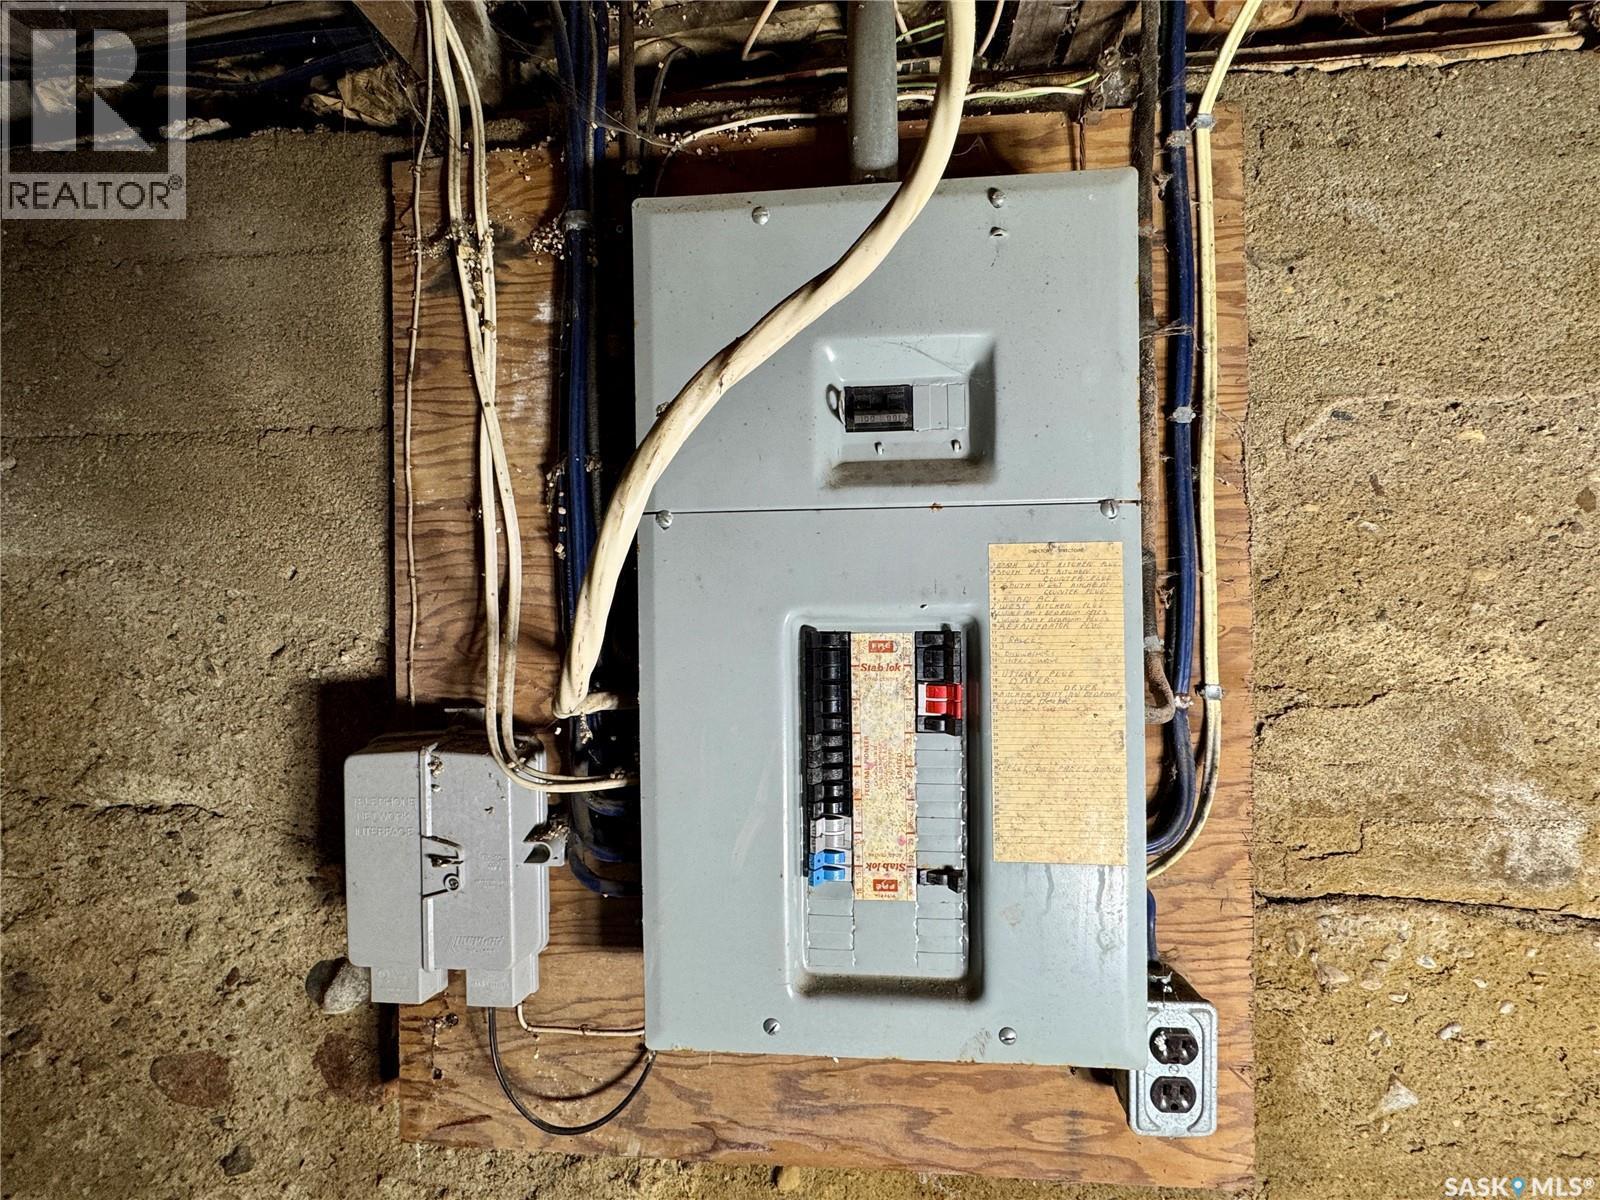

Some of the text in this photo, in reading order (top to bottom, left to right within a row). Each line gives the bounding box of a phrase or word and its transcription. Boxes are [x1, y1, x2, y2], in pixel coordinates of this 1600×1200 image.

[860, 662, 902, 672] Stab lok
[352, 796, 416, 807] TELEPHONE
[356, 811, 410, 822] NETWORK
[355, 826, 415, 837] INTERFACE
[865, 862, 906, 872] Stab lok
